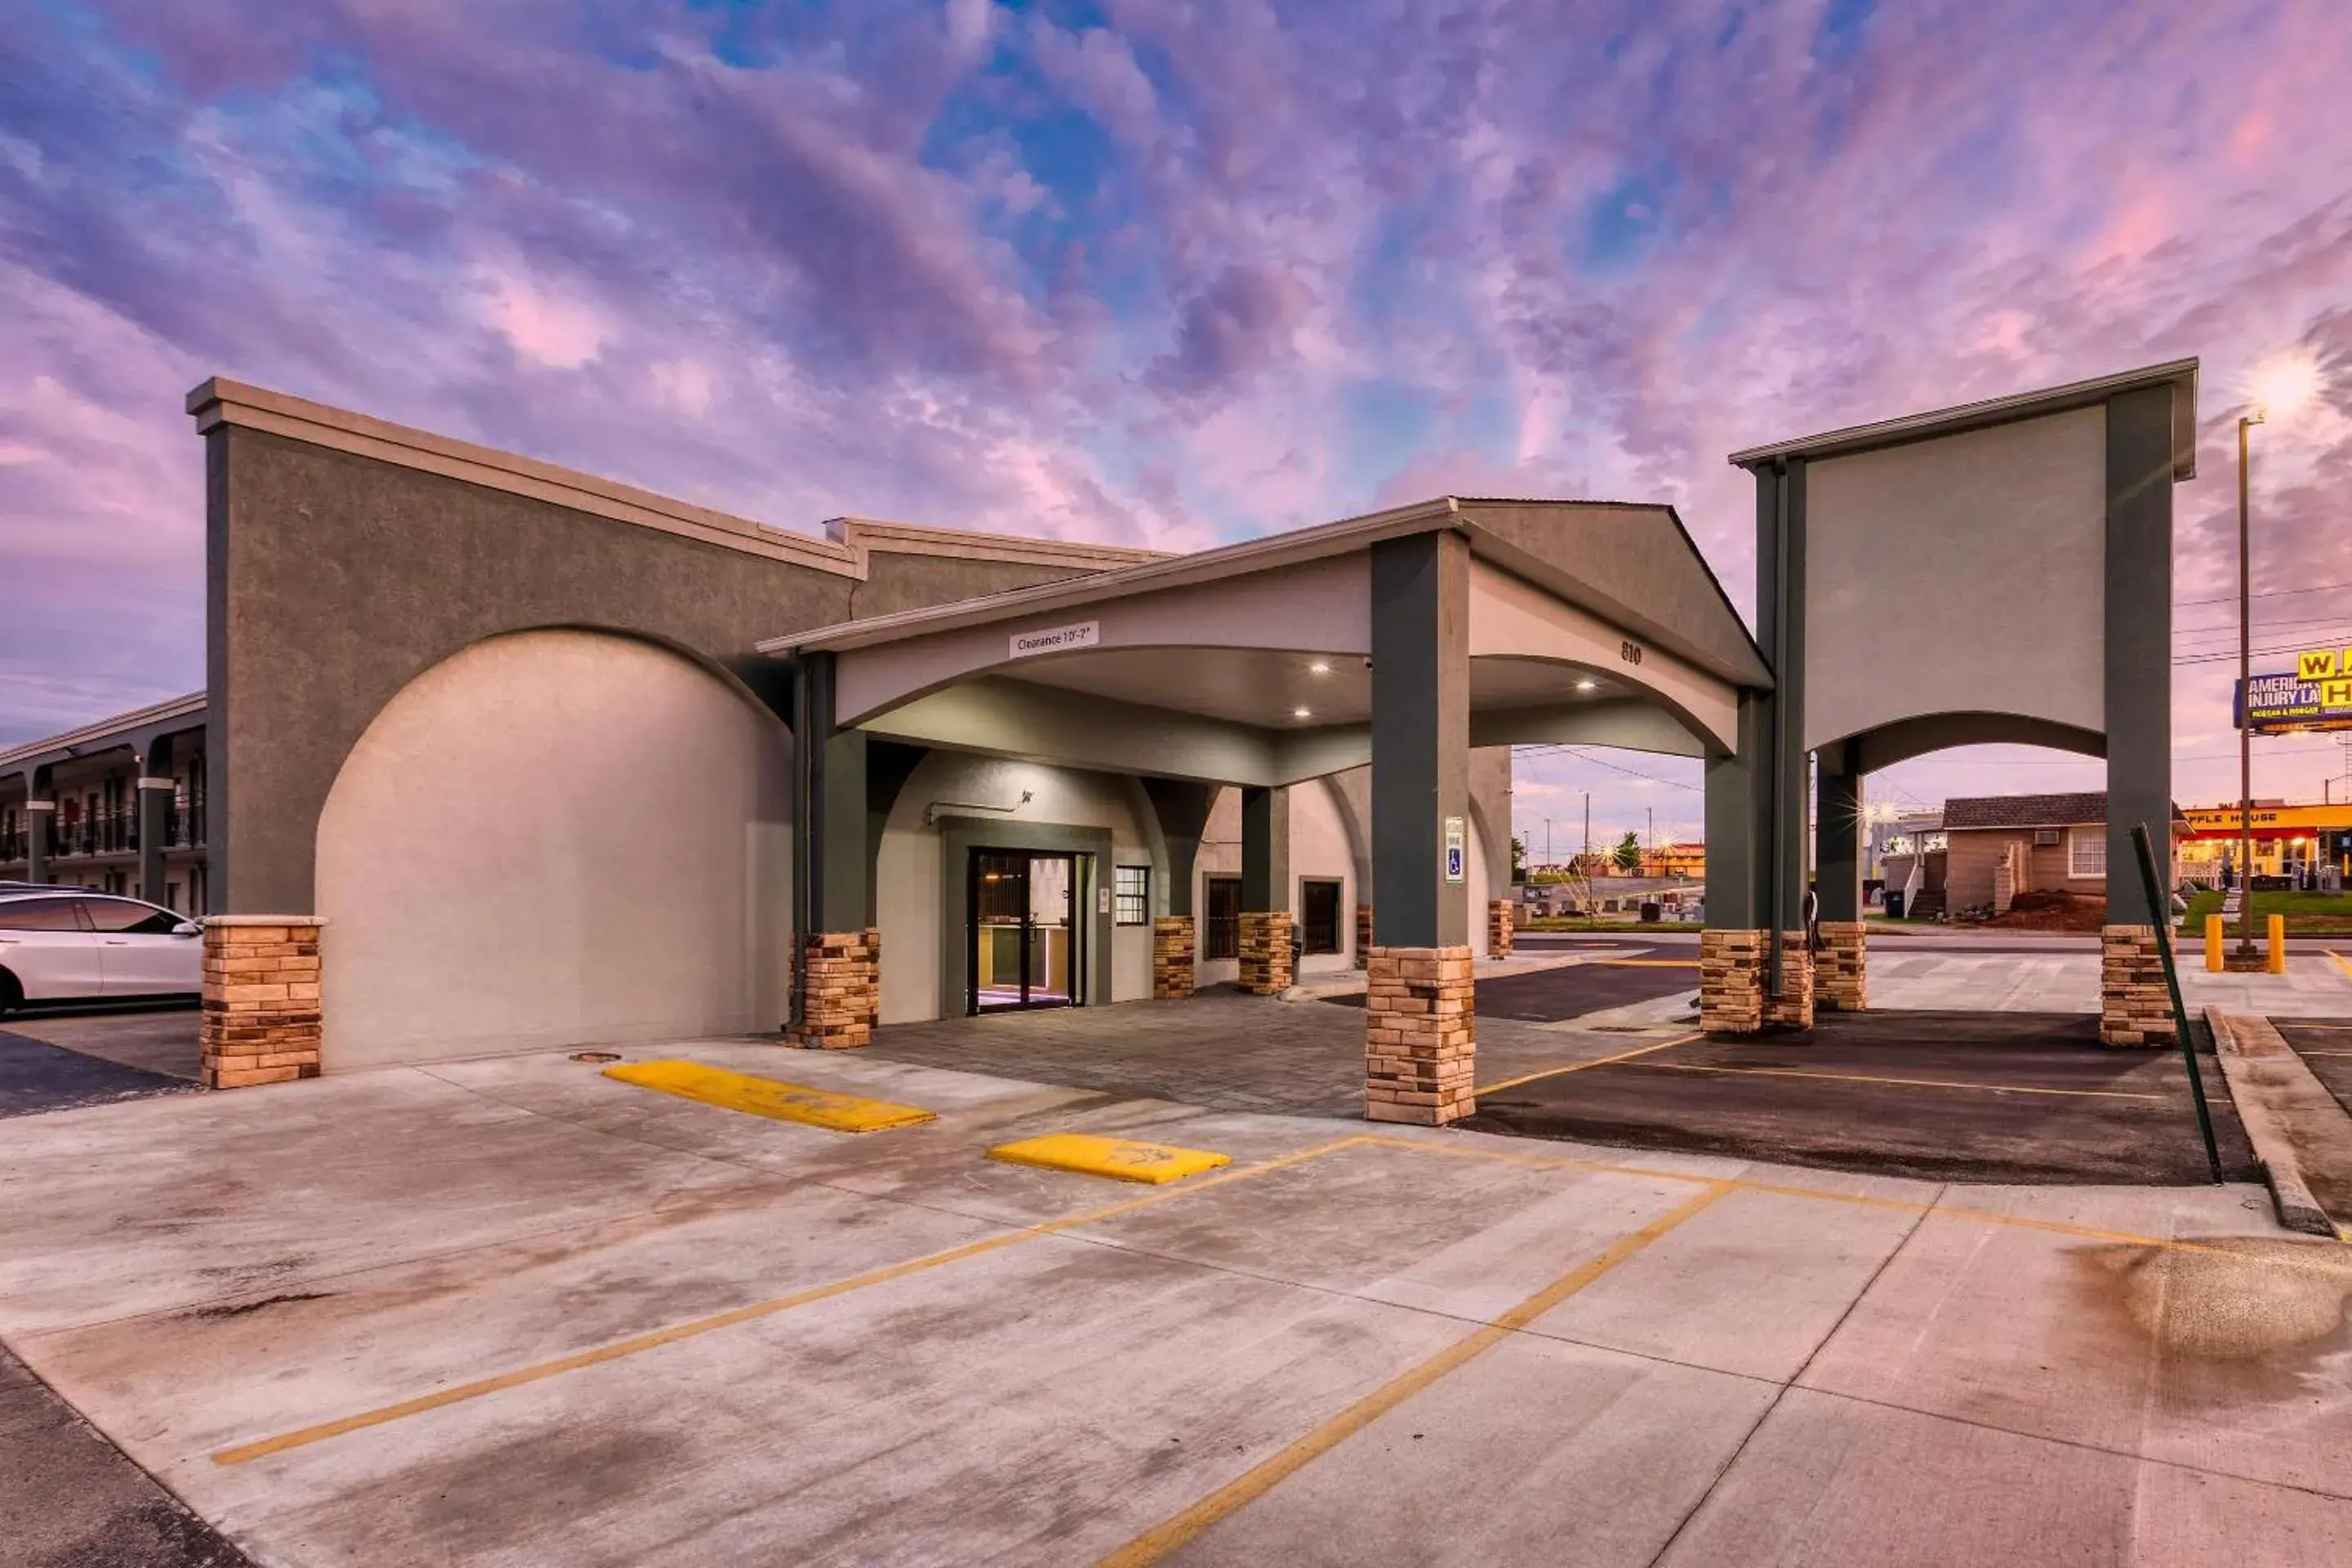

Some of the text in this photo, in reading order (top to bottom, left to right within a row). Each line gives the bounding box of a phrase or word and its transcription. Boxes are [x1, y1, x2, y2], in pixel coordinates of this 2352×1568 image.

[1018, 635, 1062, 650] Clearance
[1621, 640, 1642, 666] 810
[2248, 688, 2321, 708] INJURY LA
[2230, 813, 2277, 822] HUSE
